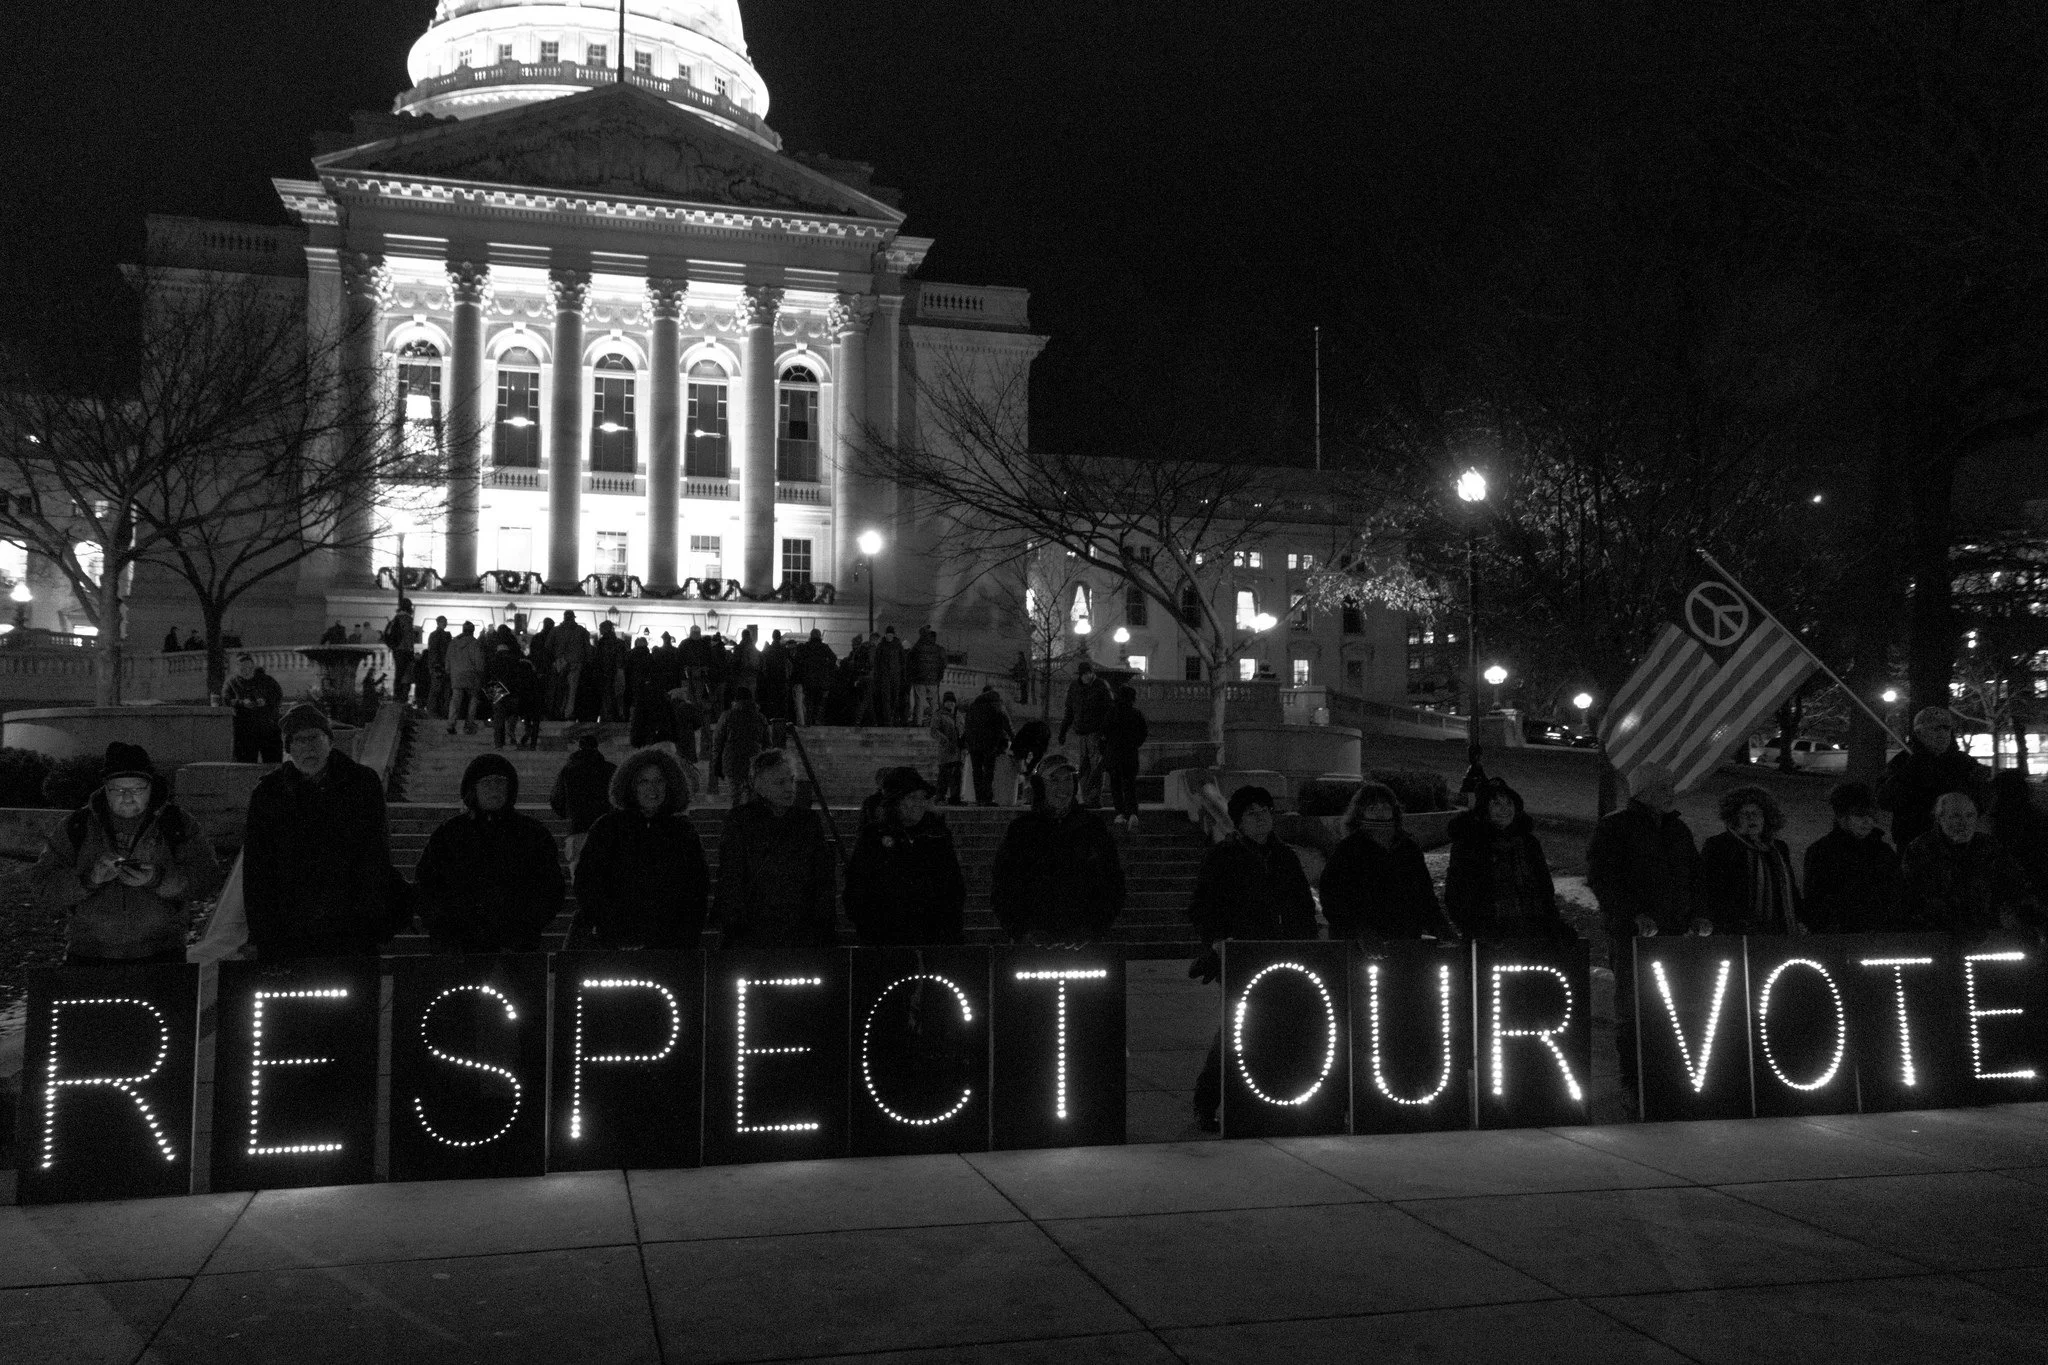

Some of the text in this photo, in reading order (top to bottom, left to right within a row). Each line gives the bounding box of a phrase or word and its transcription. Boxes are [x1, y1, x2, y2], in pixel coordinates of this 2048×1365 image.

[40, 950, 2039, 1171] RESPECT OUR VOTE
